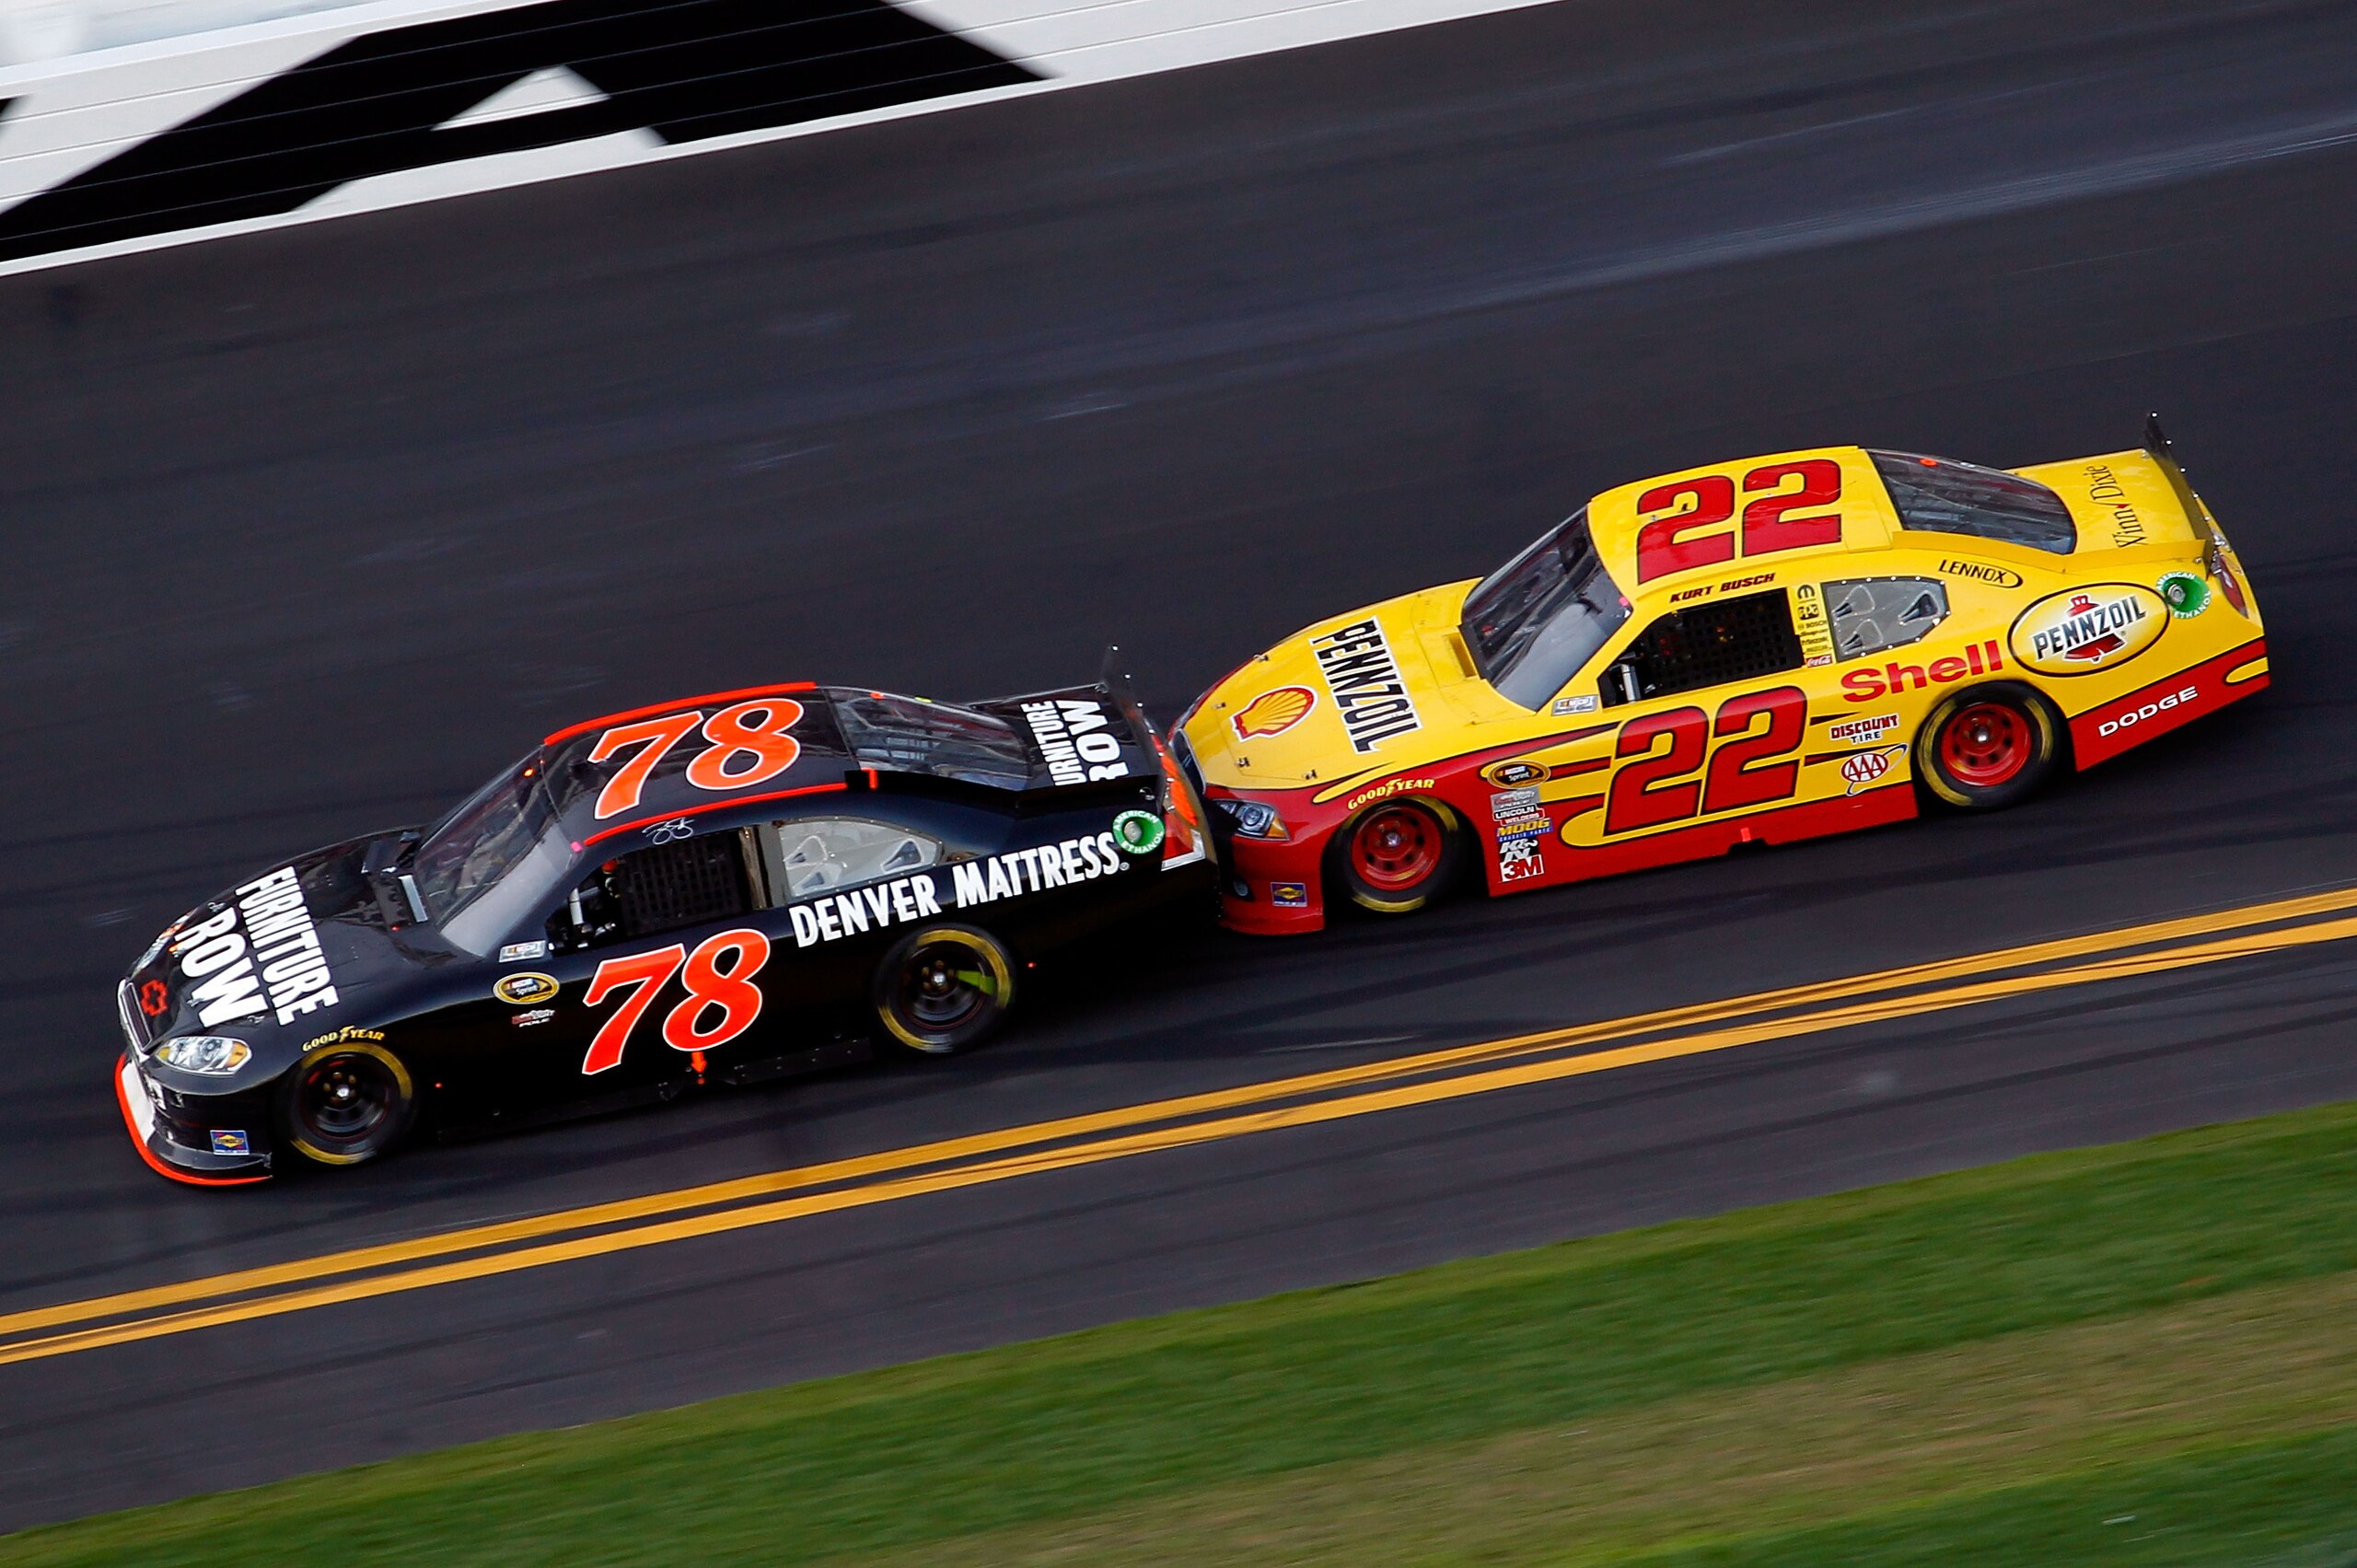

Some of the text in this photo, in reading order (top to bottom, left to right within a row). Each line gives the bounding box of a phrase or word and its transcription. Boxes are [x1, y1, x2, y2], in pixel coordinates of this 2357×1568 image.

[2083, 465, 2125, 501] Dixie
[1637, 459, 1841, 586] 22
[1670, 572, 1776, 603] KURT BUSCH
[1938, 559, 2008, 585] LENNOX
[2156, 571, 2197, 591] AMERICAN
[2174, 591, 2212, 619] ETHANOL
[2032, 595, 2147, 661] PENNZOIL
[1311, 618, 1421, 754] PENNZOIL
[1841, 640, 2003, 703] Shell
[1830, 714, 1898, 738] DISCOUNT
[2098, 686, 2198, 737] DODGE
[1020, 701, 1086, 786] URNITURE
[1054, 700, 1129, 782] ROW
[1851, 731, 1881, 743] TIRE
[587, 698, 804, 819] 78
[1603, 686, 1807, 837] 22
[1844, 753, 1887, 782] AAA
[1112, 810, 1160, 831] AMERICAN
[1495, 805, 1535, 819] LINCOLN
[1497, 819, 1550, 837] MOOG
[1504, 812, 1540, 824] WELDERS
[1120, 831, 1165, 854] ETHANOL
[1529, 827, 1551, 836] PARTS
[1502, 855, 1542, 880] 3M
[789, 875, 942, 947] DENVER
[235, 865, 340, 1027] FURNITURE
[174, 906, 269, 1028] ROW
[582, 928, 770, 1075] 78
